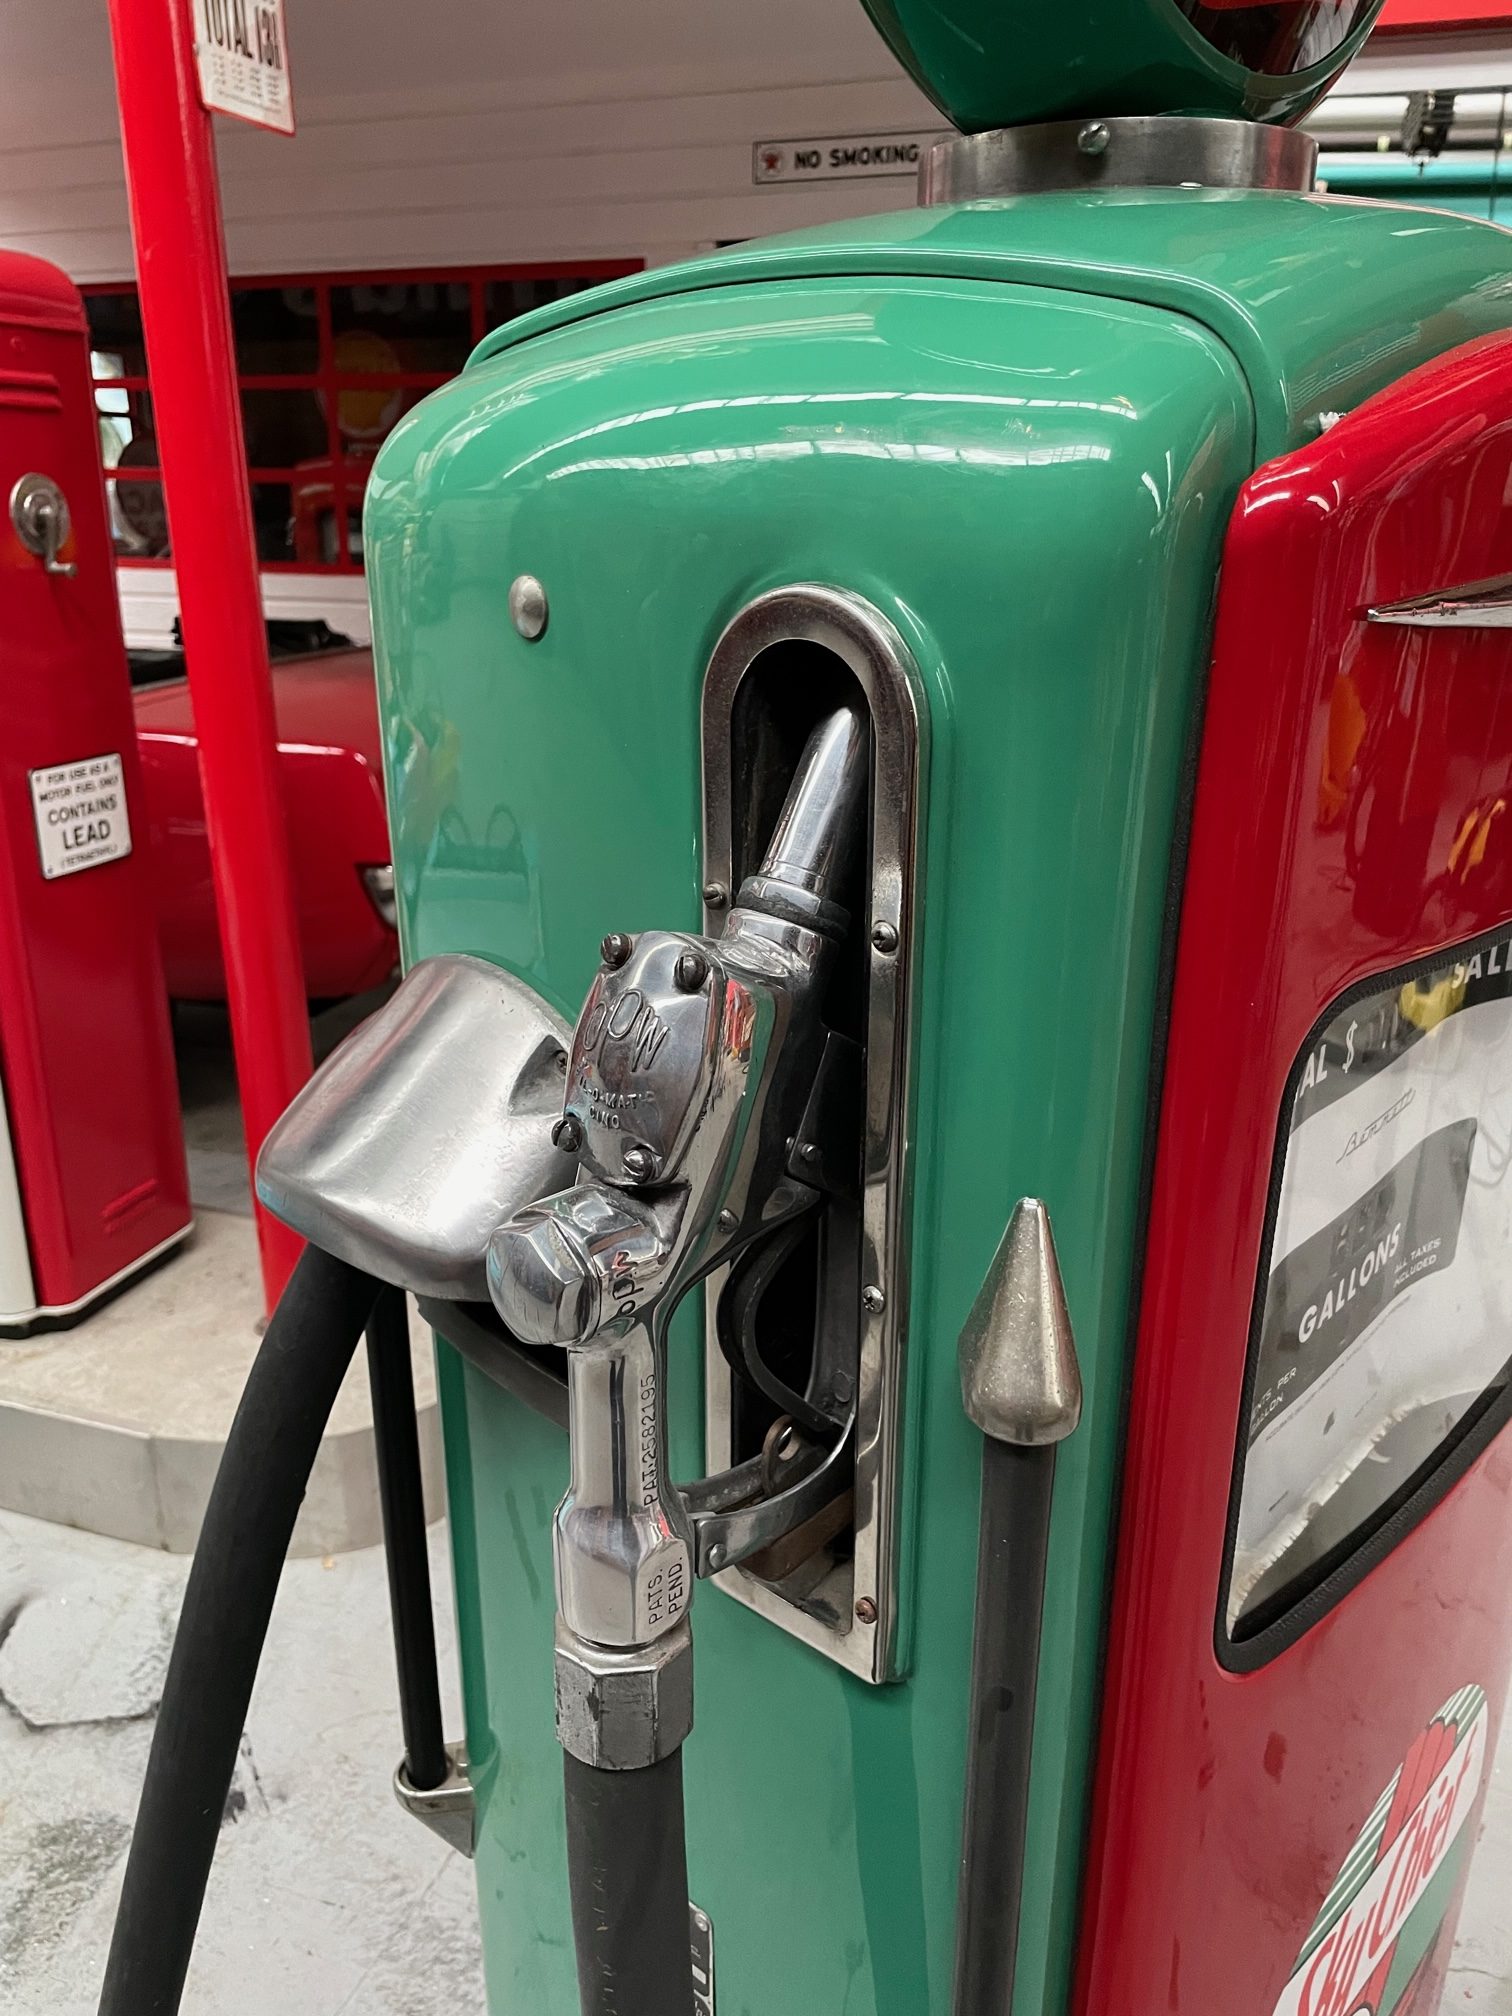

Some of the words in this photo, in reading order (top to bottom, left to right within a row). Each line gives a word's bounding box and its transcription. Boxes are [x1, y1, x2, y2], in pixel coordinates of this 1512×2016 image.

[795, 151, 821, 169] NO
[830, 144, 919, 168] SMOKING
[40, 786, 71, 801] MOTOR
[48, 794, 118, 825] CONTAINS
[62, 820, 111, 850] LEAD
[1299, 1044, 1328, 1098] AL
[1341, 1019, 1358, 1074] $
[1451, 939, 1512, 989] SAL
[1411, 1237, 1442, 1260] TAXES
[1299, 1222, 1401, 1343] GALLONS
[1277, 1367, 1297, 1390] PER
[647, 1568, 663, 1625] PATS.
[668, 1556, 683, 1615] PEND.
[1368, 1721, 1478, 1960] Chief
